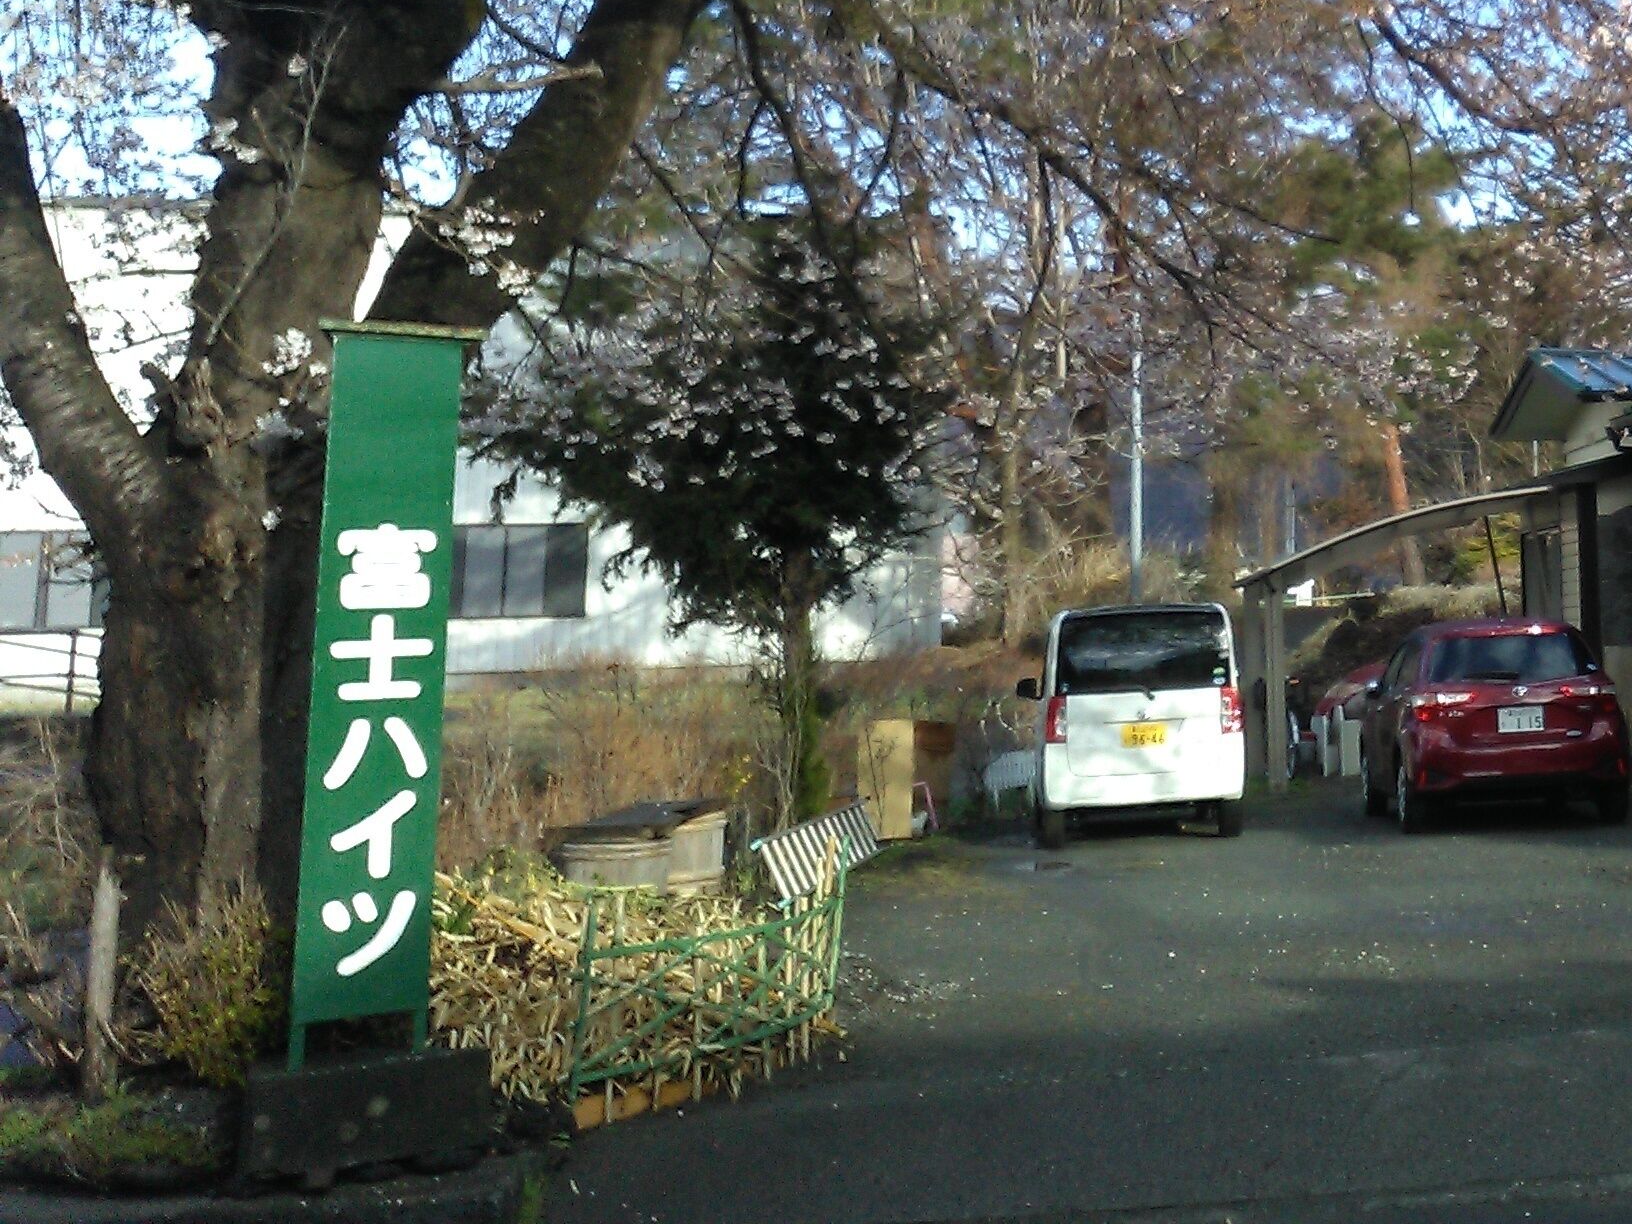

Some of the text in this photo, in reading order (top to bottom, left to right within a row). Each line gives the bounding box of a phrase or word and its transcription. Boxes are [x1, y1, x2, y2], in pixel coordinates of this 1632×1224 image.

[322, 523, 438, 976] 富士ハイツ
